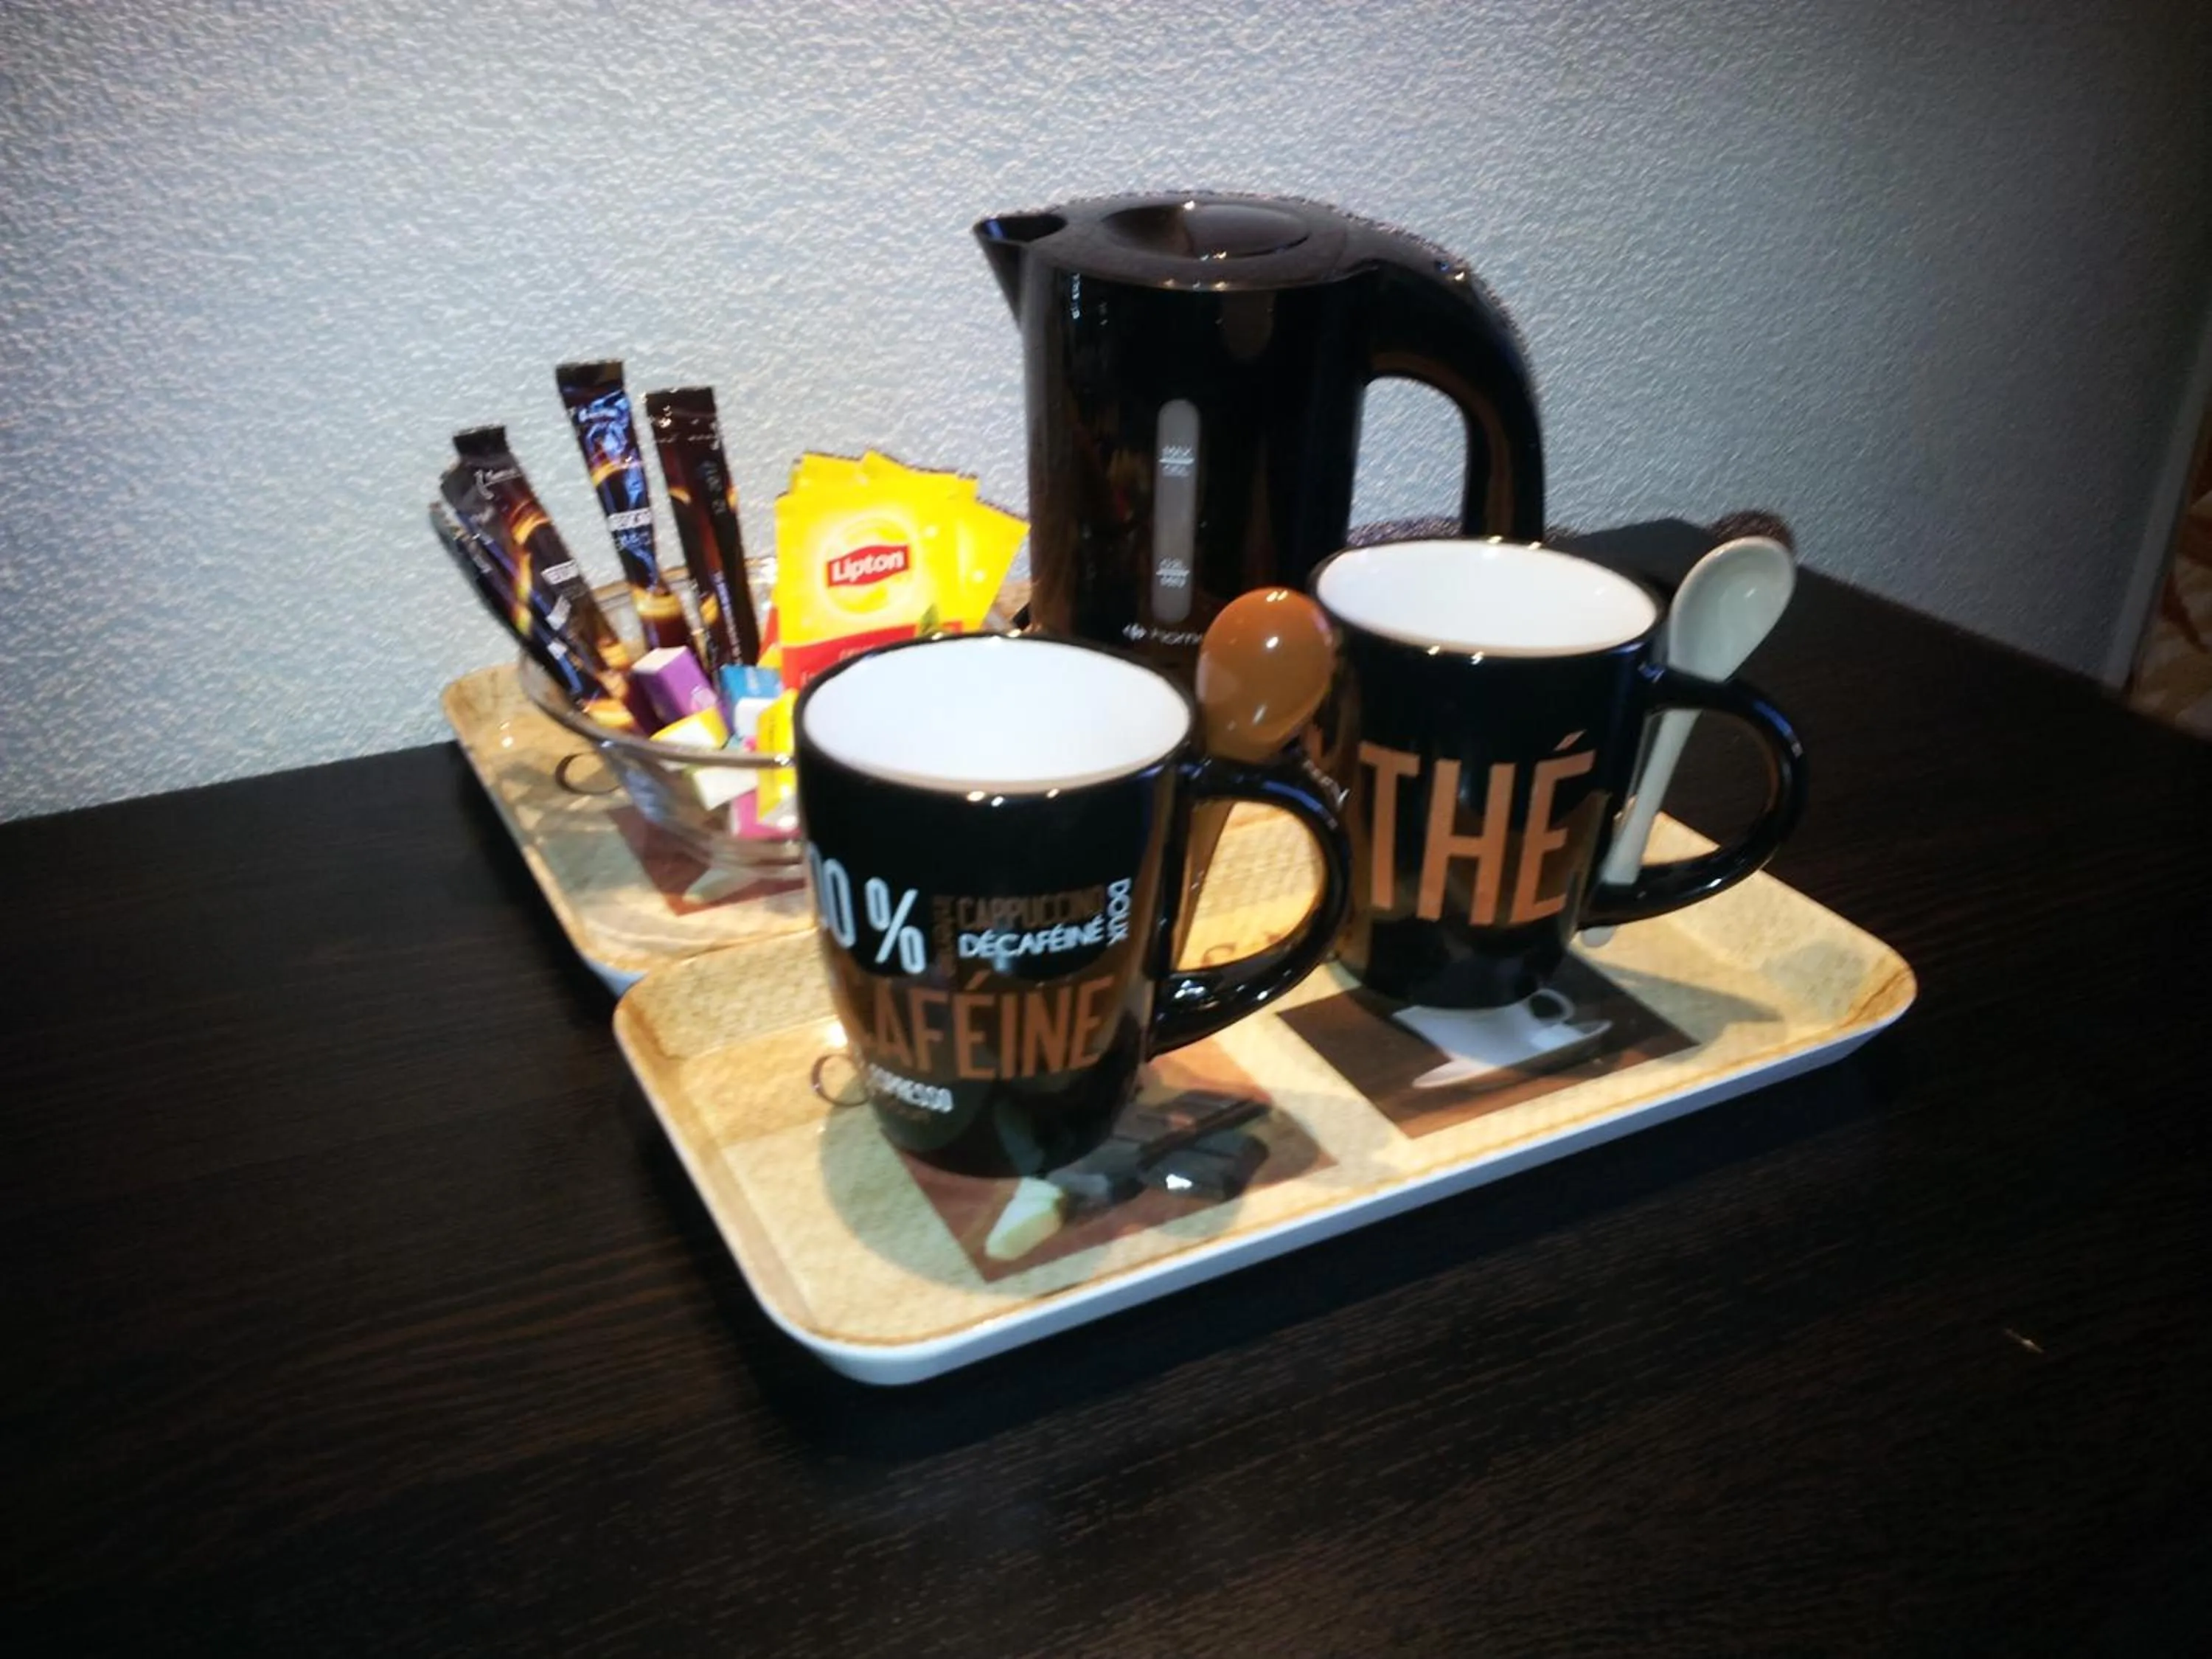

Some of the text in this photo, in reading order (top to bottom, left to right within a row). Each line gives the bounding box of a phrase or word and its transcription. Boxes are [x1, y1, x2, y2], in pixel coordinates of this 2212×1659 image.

[832, 551, 905, 583] Lipton
[1359, 730, 1596, 926] THÉ
[864, 876, 927, 975] %
[857, 970, 1113, 1081] AFÉINE
